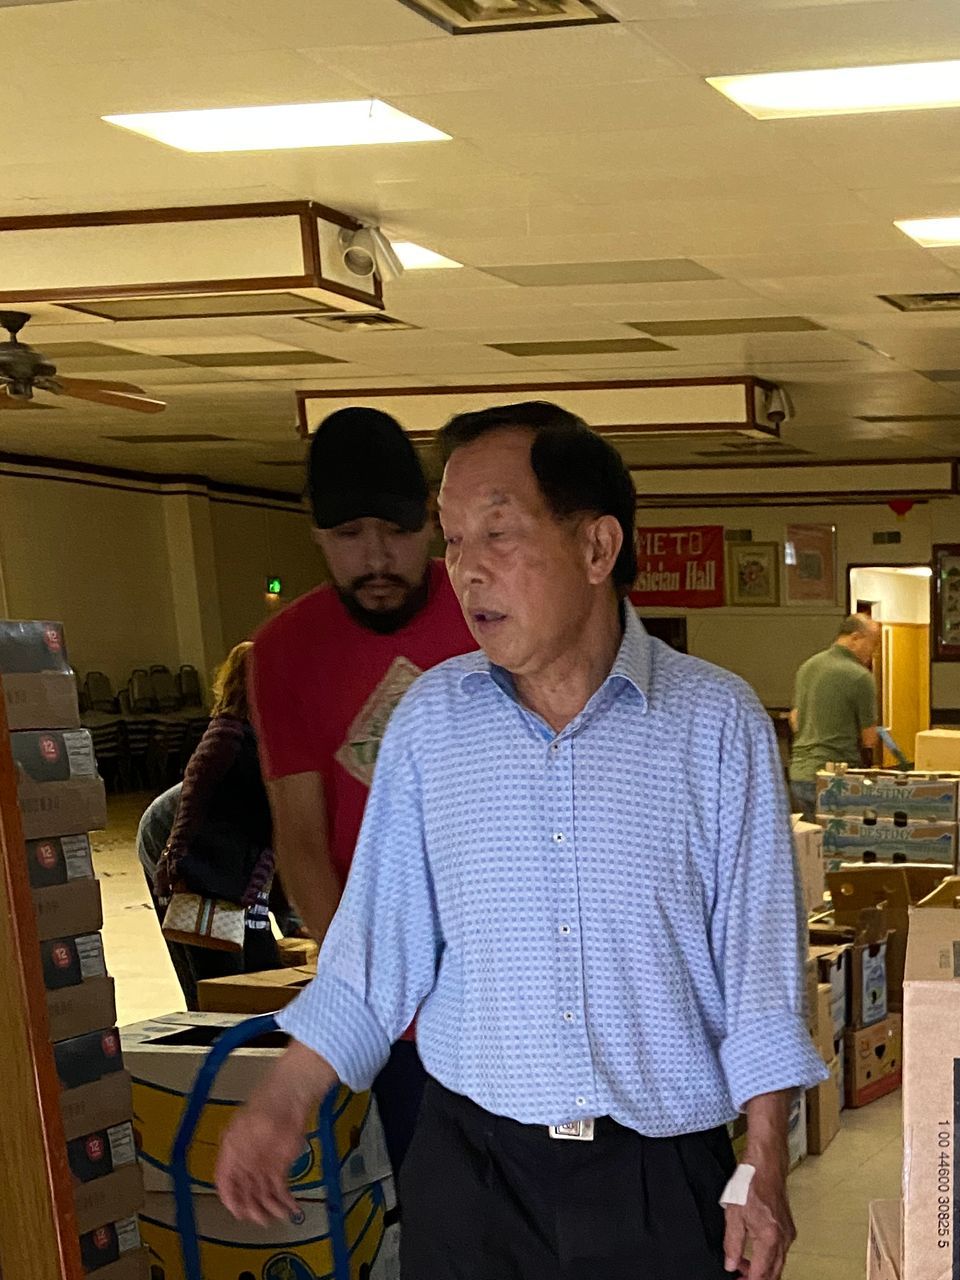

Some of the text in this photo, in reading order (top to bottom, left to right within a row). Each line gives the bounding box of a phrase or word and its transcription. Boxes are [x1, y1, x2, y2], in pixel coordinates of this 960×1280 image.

[685, 560, 716, 590] Hall
[938, 1156, 949, 1193] 44600
[937, 1195, 949, 1237] 30825
